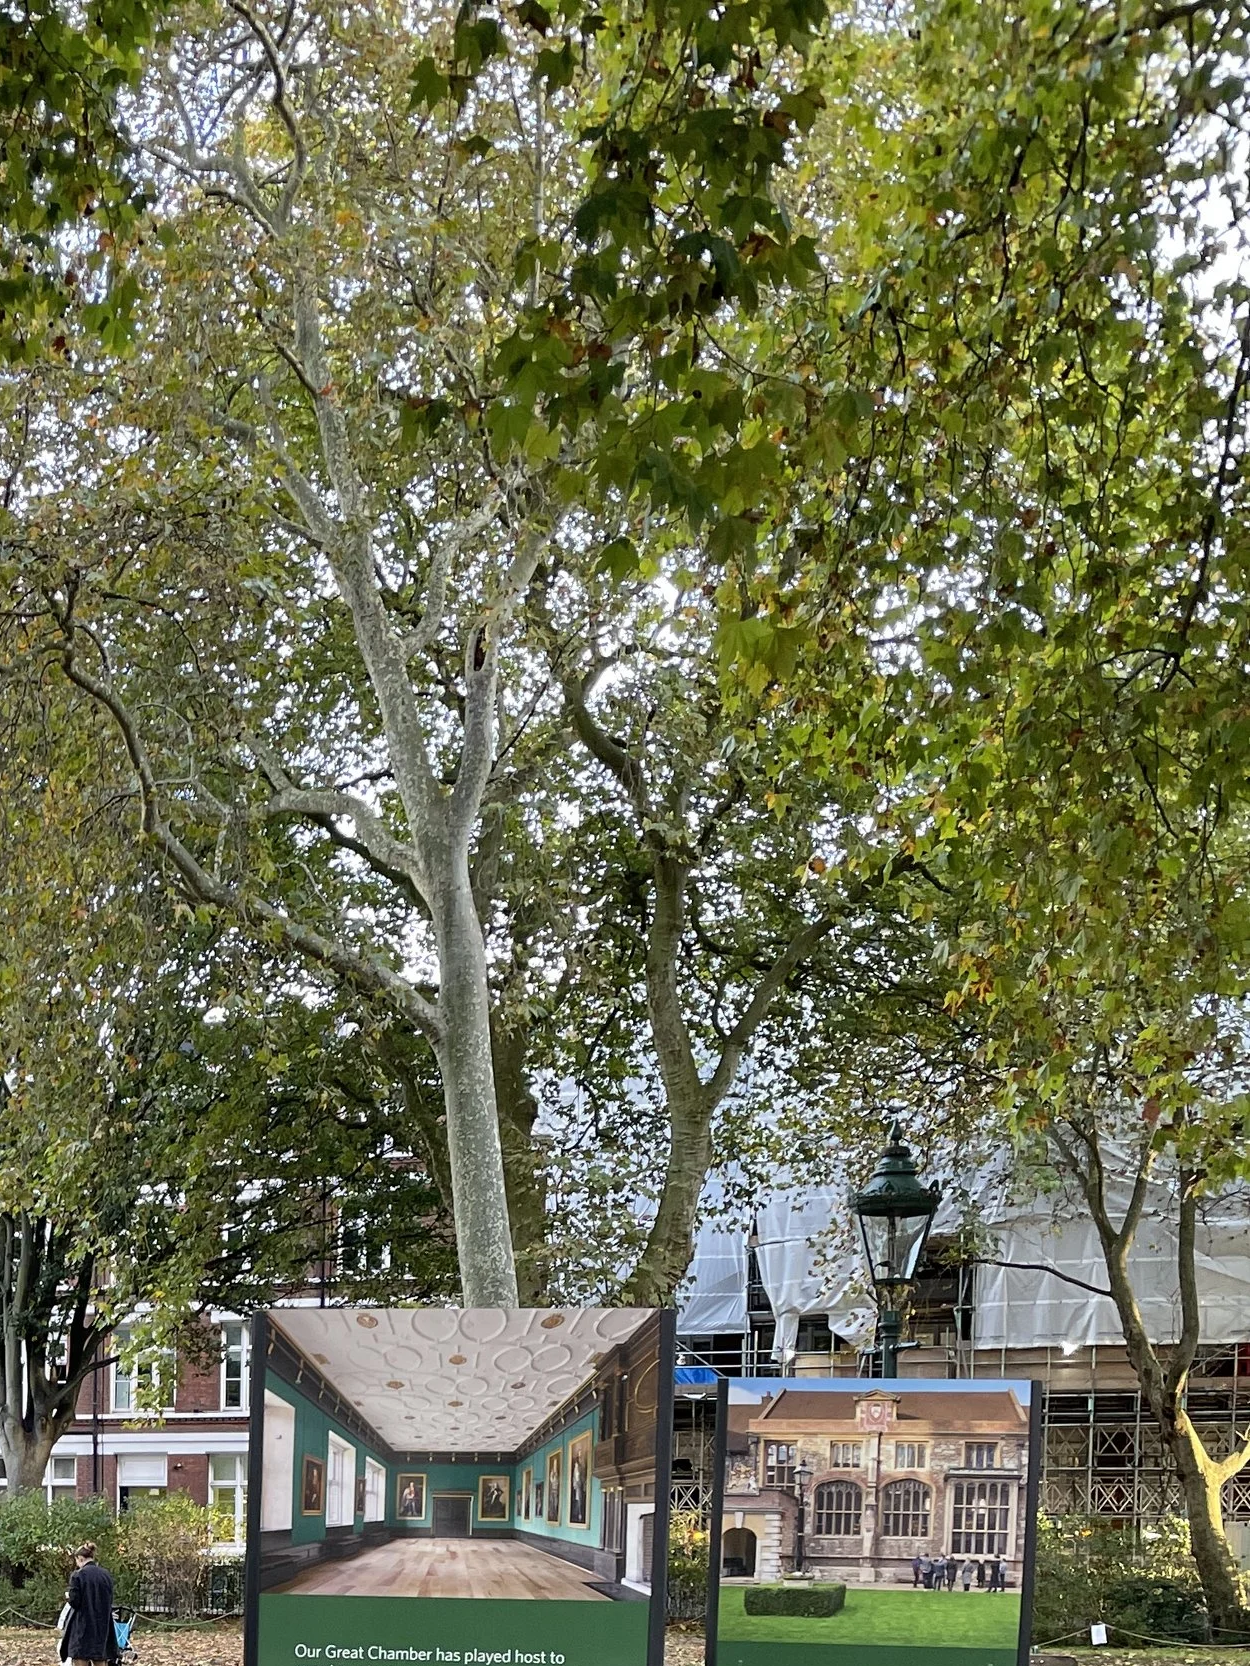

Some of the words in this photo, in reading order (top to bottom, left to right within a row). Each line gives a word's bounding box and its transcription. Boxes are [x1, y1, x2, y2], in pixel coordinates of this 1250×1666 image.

[294, 1643, 322, 1658] Our
[324, 1644, 365, 1660] Great
[367, 1645, 434, 1661] Chamber
[435, 1647, 461, 1662] has
[464, 1647, 512, 1666] played
[514, 1648, 547, 1664] host
[549, 1650, 566, 1665] to
